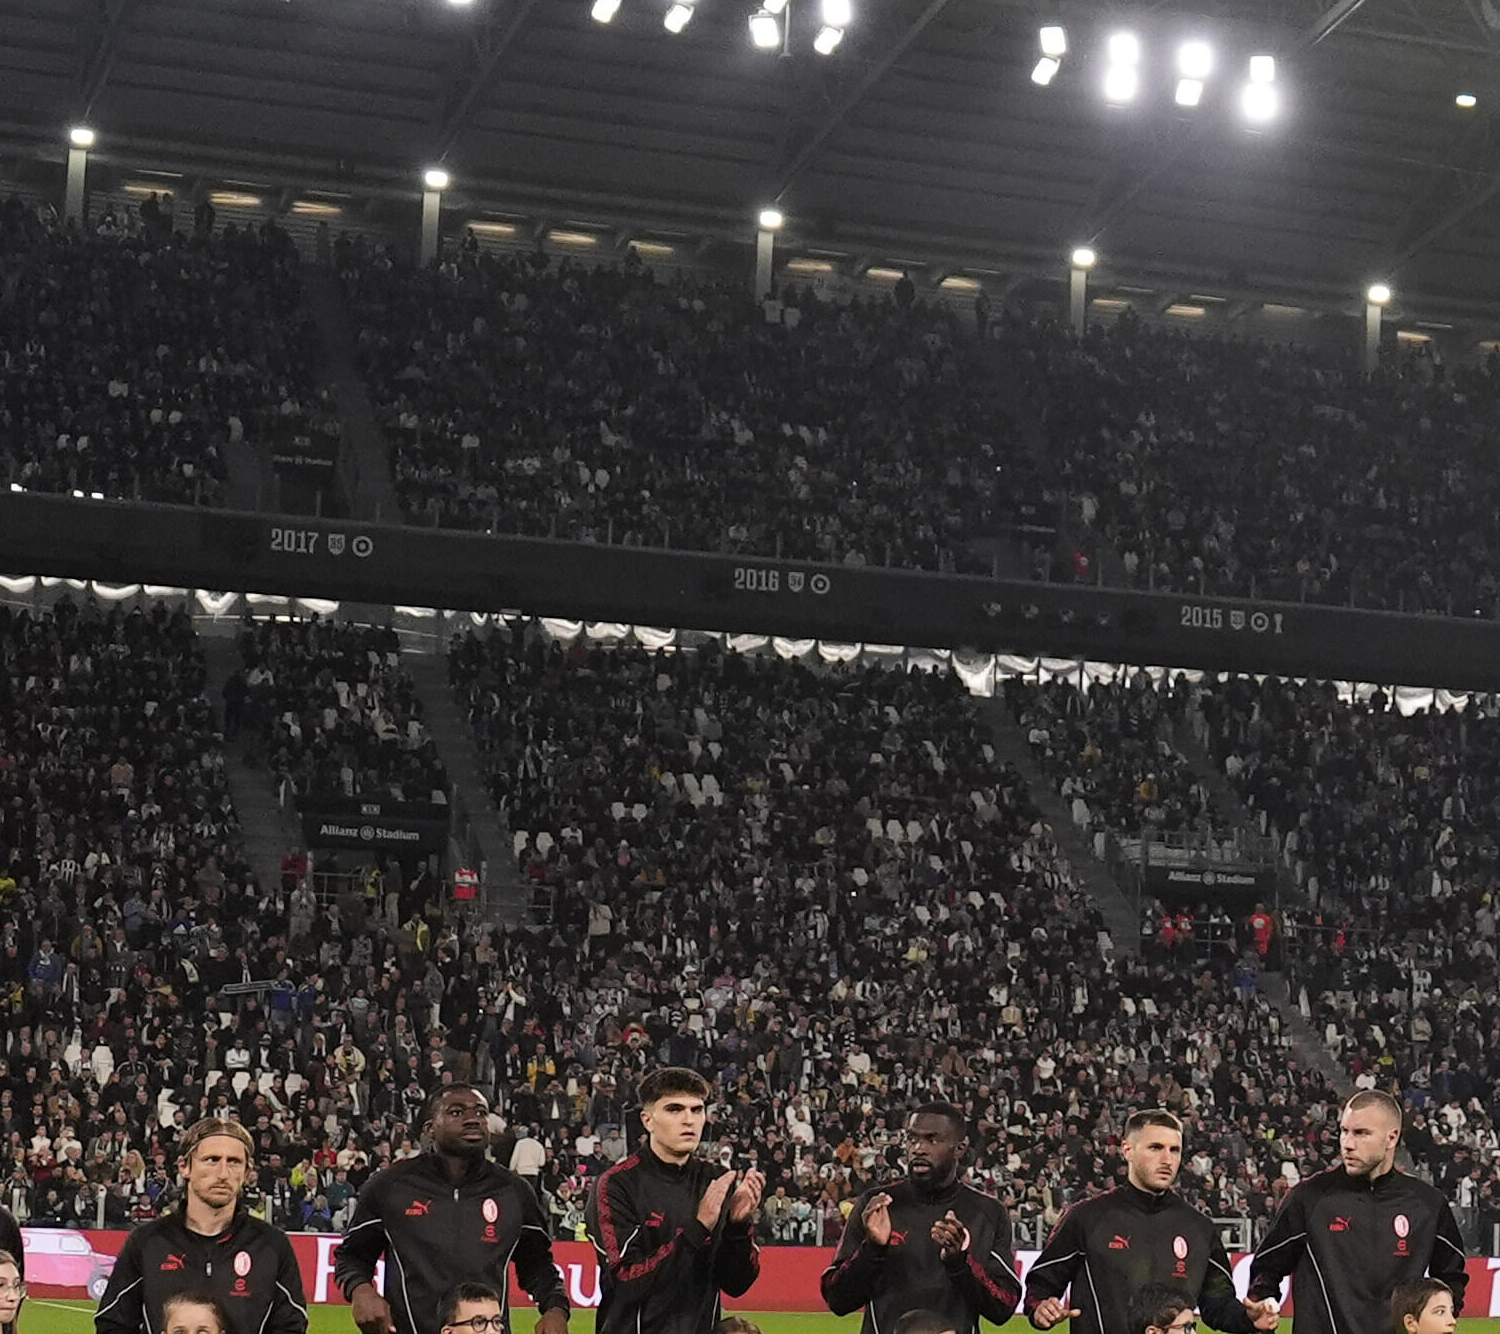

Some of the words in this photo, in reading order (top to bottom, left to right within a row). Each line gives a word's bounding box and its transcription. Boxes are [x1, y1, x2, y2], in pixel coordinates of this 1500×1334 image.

[270, 528, 319, 554] 2017
[734, 567, 779, 591] 2016
[1180, 606, 1222, 629] 2015
[319, 824, 359, 838] Allianz
[376, 827, 420, 841] Stadium
